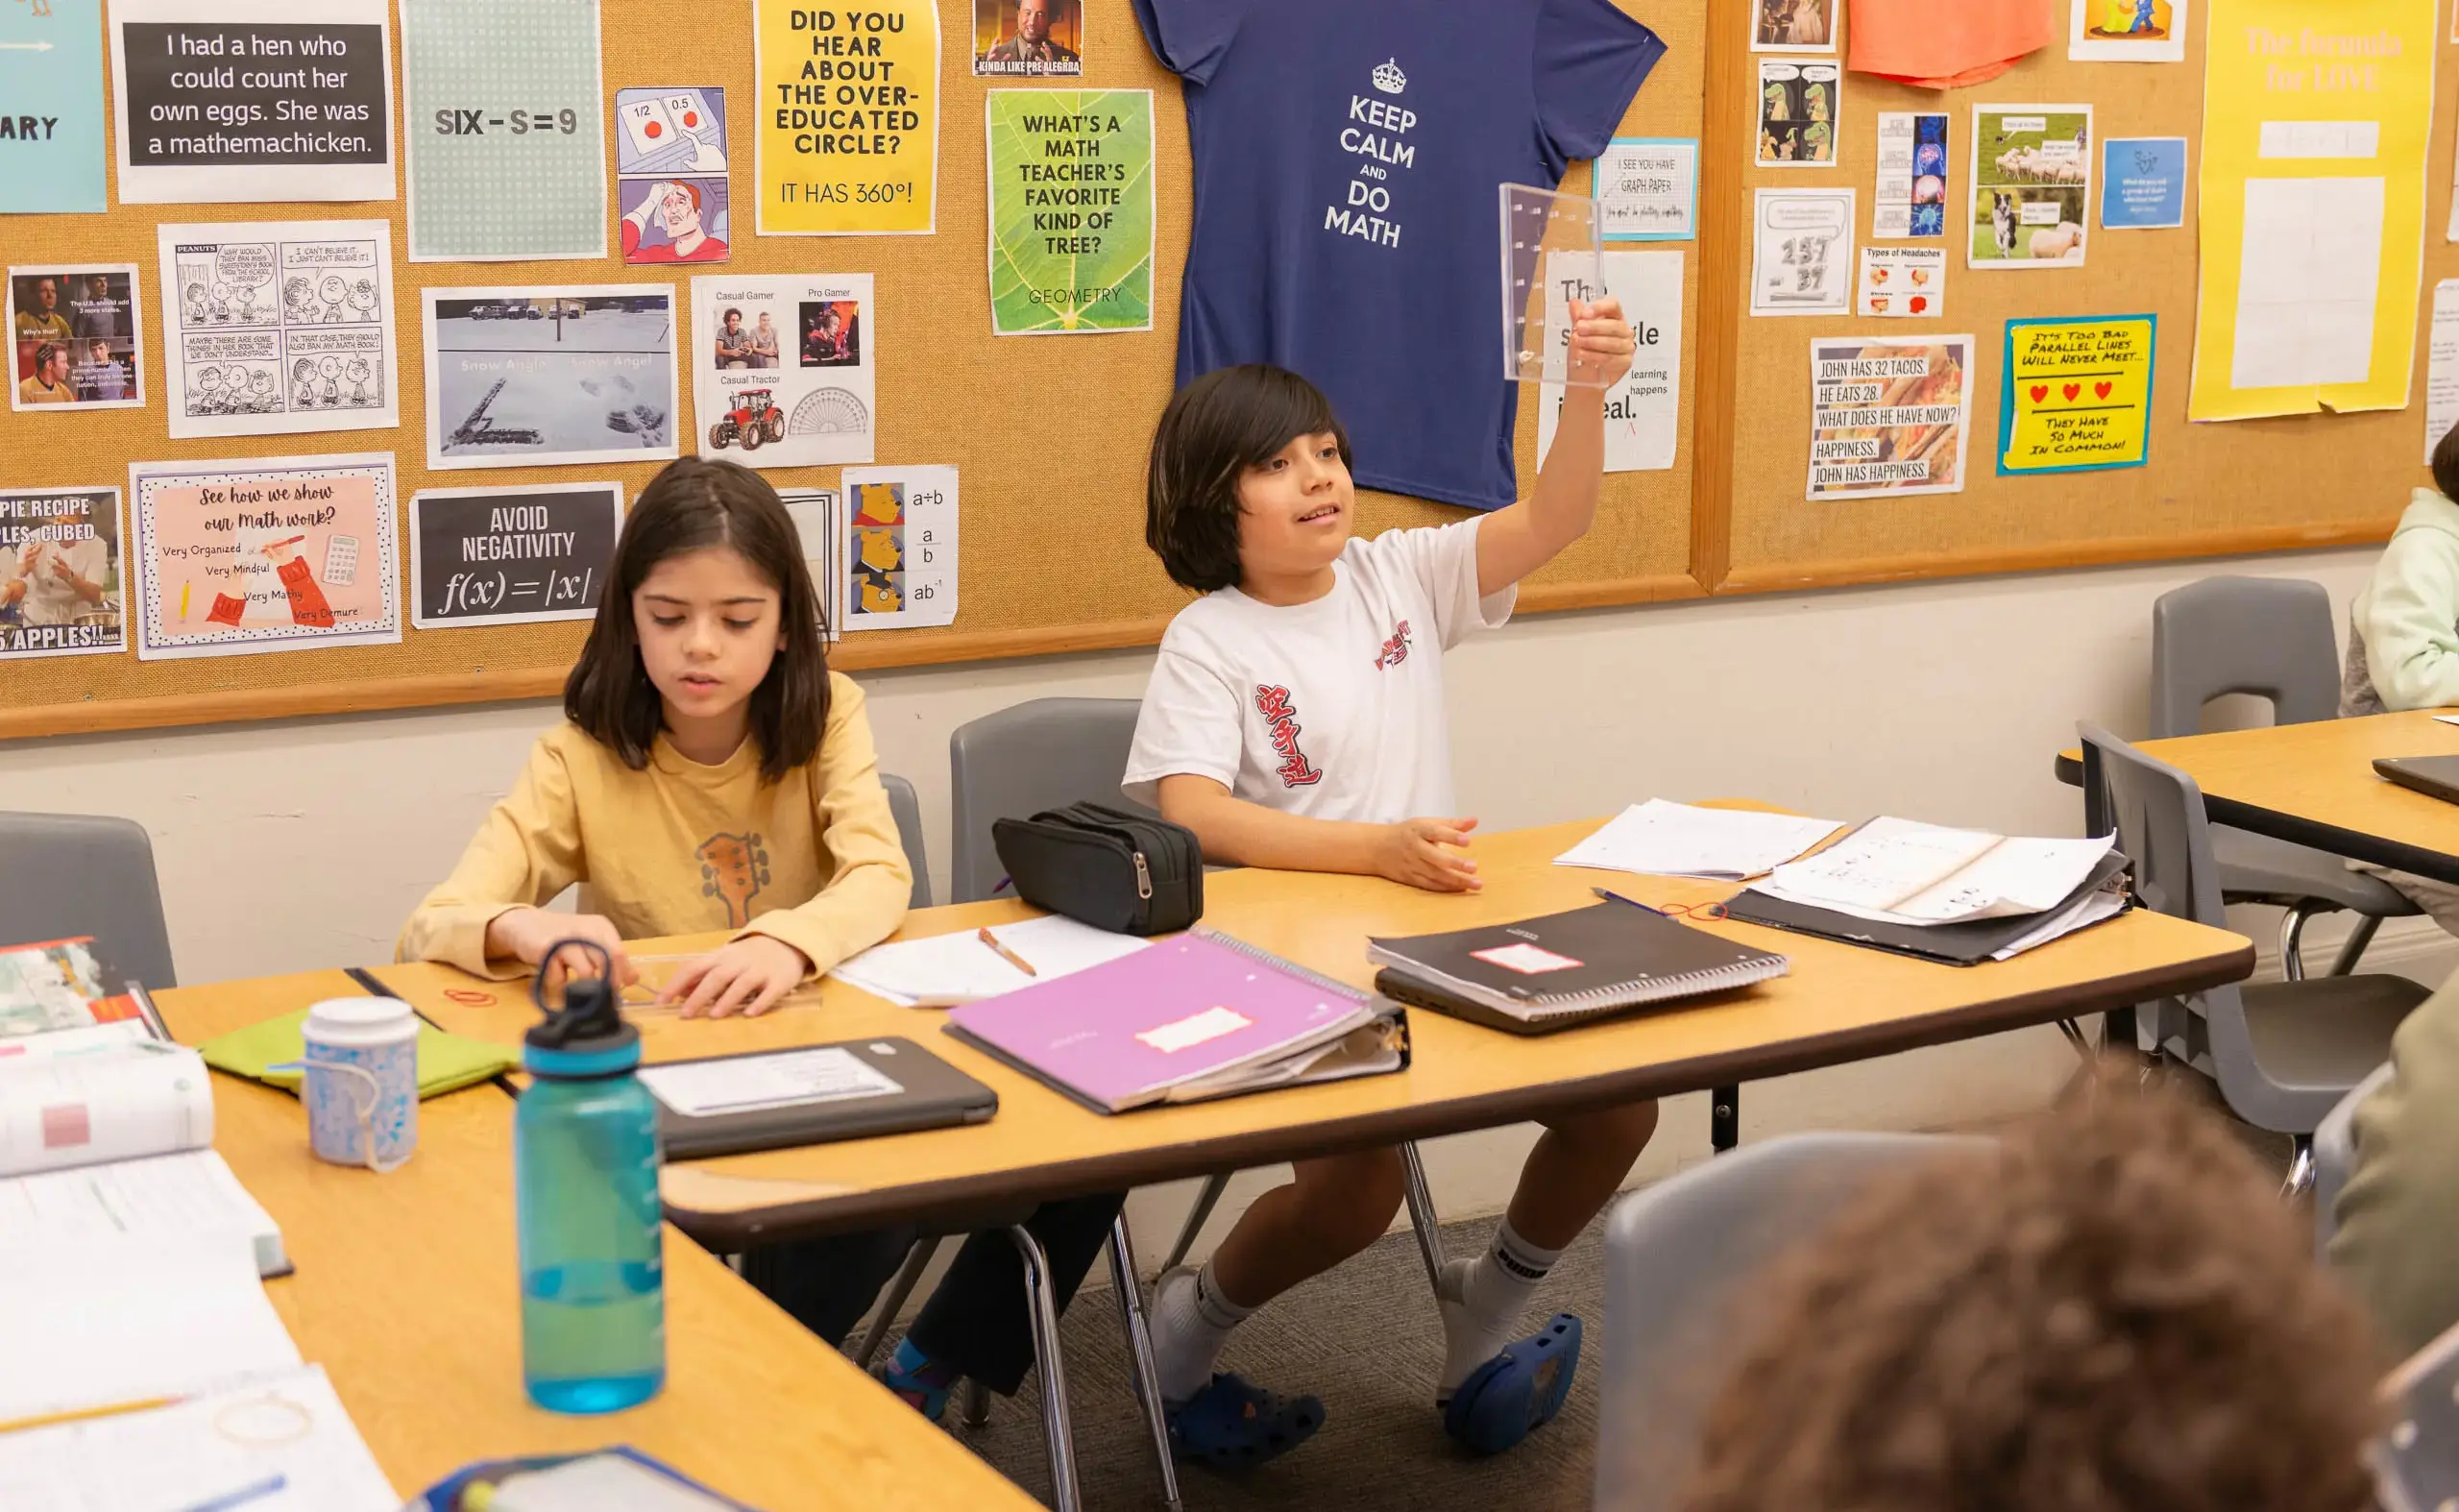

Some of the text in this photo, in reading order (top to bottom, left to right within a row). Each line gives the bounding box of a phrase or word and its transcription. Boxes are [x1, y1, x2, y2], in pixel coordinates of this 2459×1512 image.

[791, 11, 904, 33] DID YOU
[167, 34, 347, 56] I had a hen who
[814, 36, 881, 56] HEAR
[2244, 27, 2402, 58] The formula
[801, 61, 894, 82] ABOUT
[980, 61, 1006, 72] KINDA
[1008, 61, 1026, 72] LIKE
[1027, 61, 1042, 72] PRE
[170, 67, 347, 88] could count her
[2266, 64, 2379, 91] for LOVE
[672, 99, 689, 110] 0.5
[777, 85, 918, 107] THE OVER-
[150, 100, 369, 126] own eggs. She was
[634, 105, 651, 117] 1/2
[1349, 95, 1417, 134] KEEP
[776, 110, 918, 131] EDUCATED
[1023, 115, 1121, 133] WHAT'S A
[148, 133, 372, 154] a mathemachicken.
[794, 134, 901, 155] CIRCLE?
[1045, 139, 1100, 157] MATH
[1340, 128, 1415, 168] CALM
[1019, 163, 1125, 182] TEACHER'S
[1360, 164, 1386, 180] AND
[1623, 159, 1637, 169] SEE
[1639, 159, 1653, 169] YOU
[1656, 159, 1675, 169] HAVE
[782, 183, 797, 203] IT
[806, 183, 848, 203] HAS
[1621, 179, 1671, 193] GRAPH PAPER
[1026, 188, 1120, 206] FAVORITE
[1348, 180, 1390, 212] DO
[1034, 211, 1113, 230] KIND OF
[1325, 206, 1400, 248] MATH
[1045, 236, 1101, 255] TREE?
[1867, 248, 1940, 257] Types of Headaches
[1029, 288, 1122, 304] GEOMETRY
[2103, 330, 2129, 339] BAD
[2030, 340, 2132, 354] PARALLEL LINES
[462, 360, 499, 372] Snow
[614, 354, 652, 369] Angel
[1821, 359, 1926, 378] JOHN HAS 32 TACOS.
[2022, 355, 2055, 366] WILL
[2060, 354, 2097, 364] NEVER
[720, 376, 748, 384] Casual
[1631, 369, 1668, 381] learning
[1630, 385, 1668, 396] happens
[1820, 385, 1879, 402] HE EATS 28.
[1818, 407, 1956, 427] WHAT DOES HE HAVE NOW?
[2046, 416, 2109, 428] THEY HAVE
[2050, 430, 2104, 442] SO MUCH
[1816, 442, 1876, 458] HAPPINESS.
[2029, 440, 2126, 455] IN COMMON!
[1814, 463, 1926, 483] JOHN HAS HAPPINESS.
[200, 483, 335, 505] See how we show
[913, 490, 943, 506] a÷b
[31, 499, 89, 518] RECIPE
[205, 506, 335, 531] our Math work?
[490, 506, 548, 532] AVOID
[40, 524, 95, 541] CUBED
[922, 529, 932, 543] a
[162, 543, 241, 559] Very Organized
[462, 532, 575, 562] NEGATIVITY
[924, 549, 933, 562] b
[206, 563, 270, 579] Very Mindful
[243, 589, 303, 603] Very Mathy
[294, 607, 358, 623] Very Demure
[13, 625, 104, 650] APPLES!!
